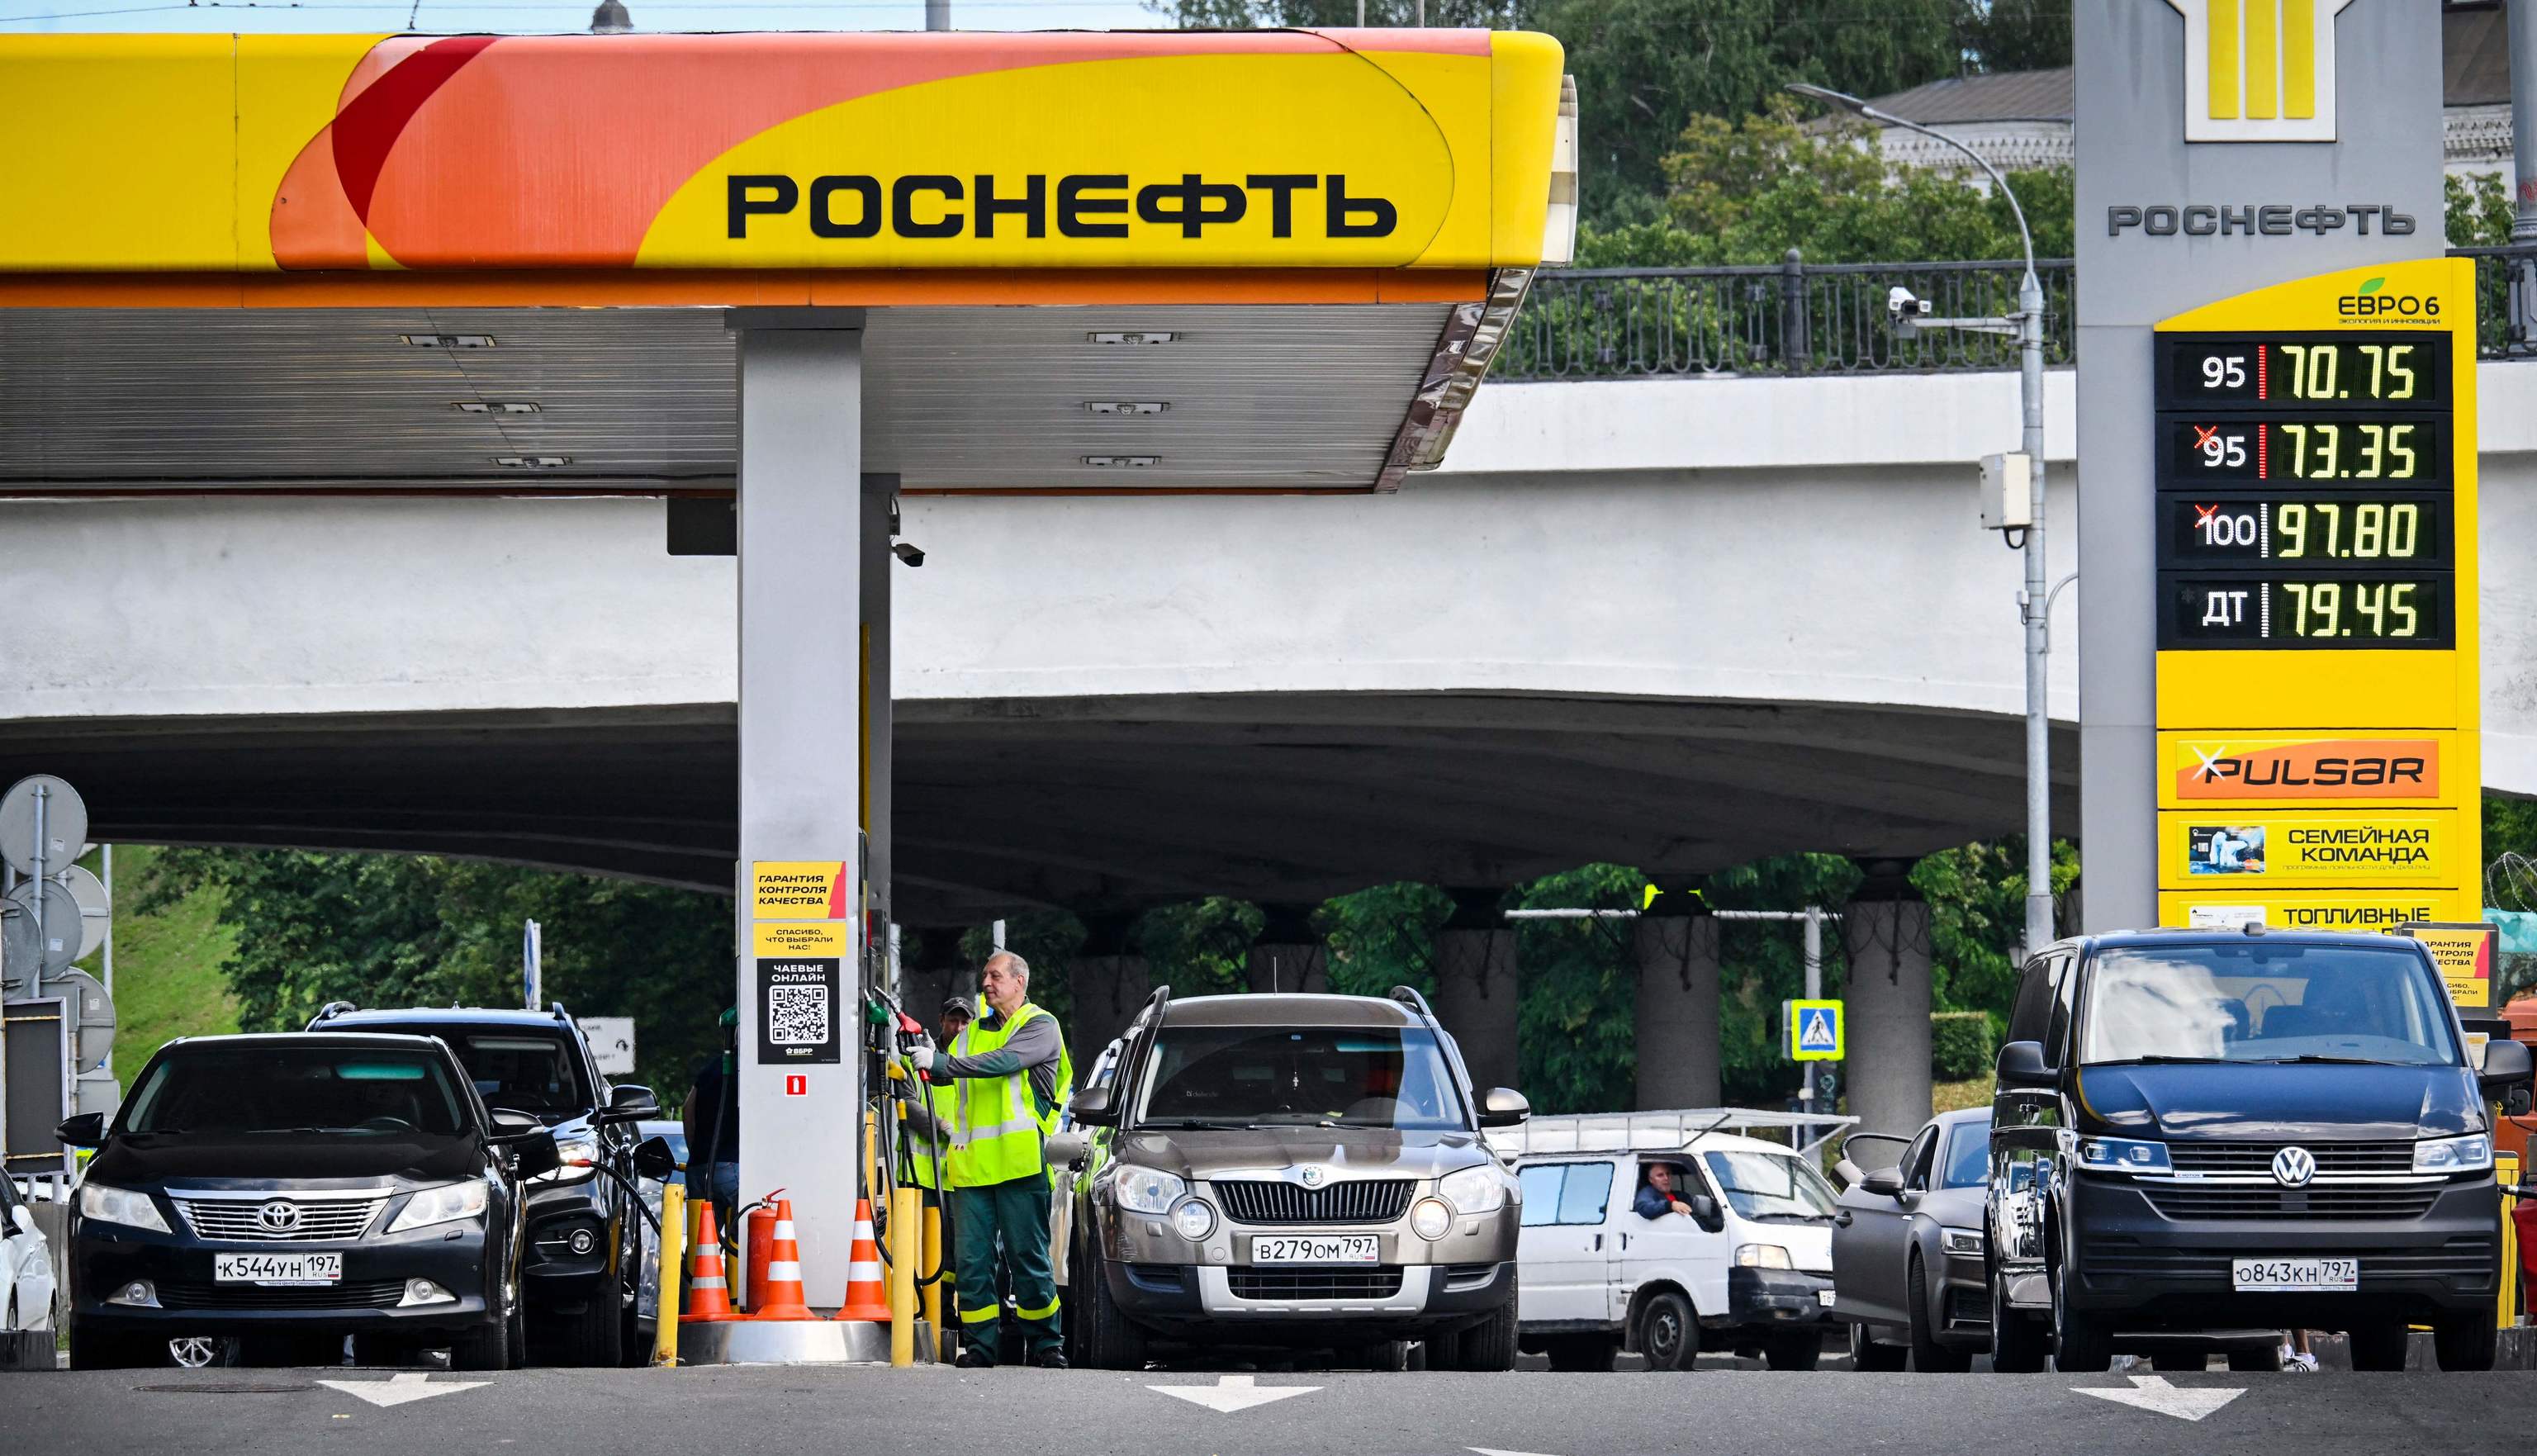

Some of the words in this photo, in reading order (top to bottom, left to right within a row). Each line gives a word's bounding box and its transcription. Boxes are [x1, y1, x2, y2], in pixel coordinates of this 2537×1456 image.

[727, 173, 1398, 239] РОСНЕФТЬ
[2108, 205, 2416, 236] РОСНЕФТЬ
[2338, 296, 2421, 315] ЕВРО
[2425, 296, 2440, 315] 6
[2203, 357, 2245, 388] 95
[2280, 345, 2415, 399] 70.75
[2203, 435, 2246, 467] 95
[2280, 424, 2416, 478] 73.35
[2197, 514, 2256, 546] 100
[2279, 504, 2417, 557] 97.80
[2202, 591, 2248, 626] ДТ
[2283, 583, 2416, 637] 79.45
[2288, 827, 2430, 844] СЕМЕЙНАЯ
[2302, 847, 2430, 864] КОМАНДА
[2283, 908, 2430, 924] ТОПЛИВНЫЕ
[771, 974, 826, 983] ОНЛАЙН
[774, 965, 824, 973] ЧАЕВЫЕ
[1260, 1240, 1340, 1259] В279ОМ
[1342, 1239, 1373, 1254] 797
[223, 1257, 301, 1278] К544УН
[306, 1256, 335, 1272] 197
[2240, 1264, 2317, 1283] О843КН
[2321, 1261, 2351, 1277] 797
